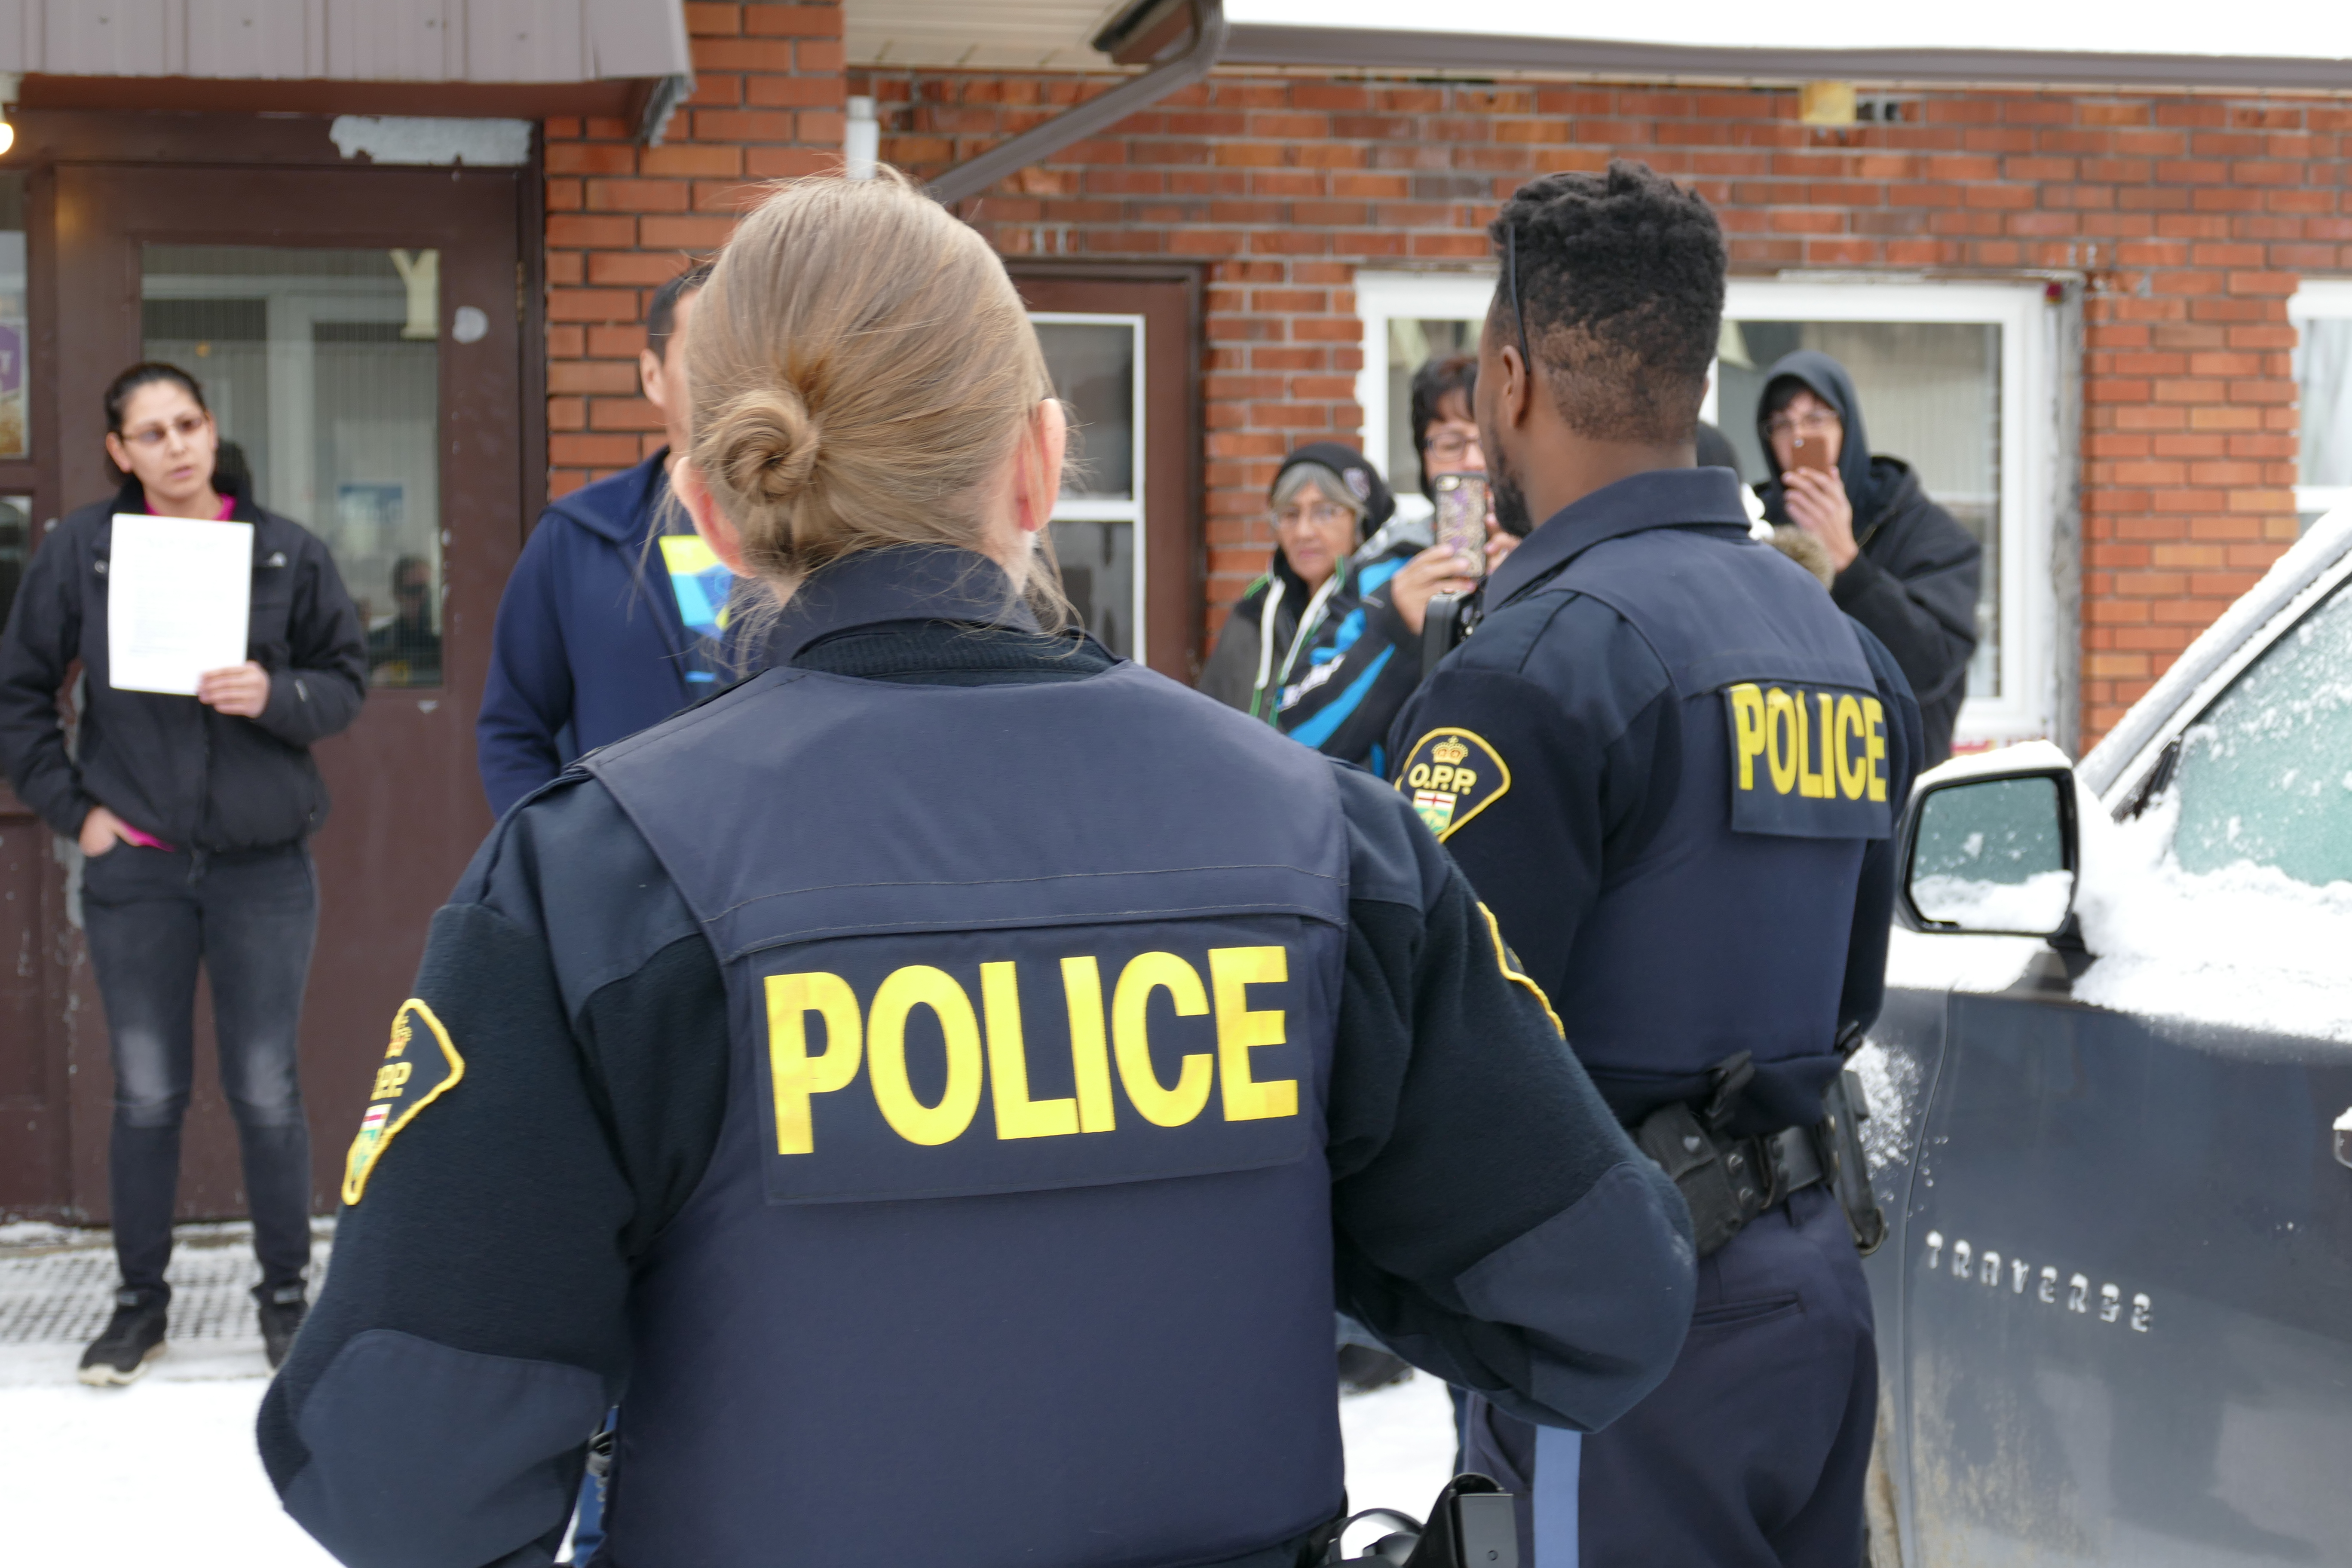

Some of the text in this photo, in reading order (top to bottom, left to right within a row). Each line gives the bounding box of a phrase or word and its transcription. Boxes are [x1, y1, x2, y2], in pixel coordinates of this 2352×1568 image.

[1409, 763, 1477, 795] O.P.P.
[1729, 683, 1886, 802] POLICE
[764, 945, 1298, 1155] POLICE
[1926, 1229, 2153, 1332] TRAVERSE
